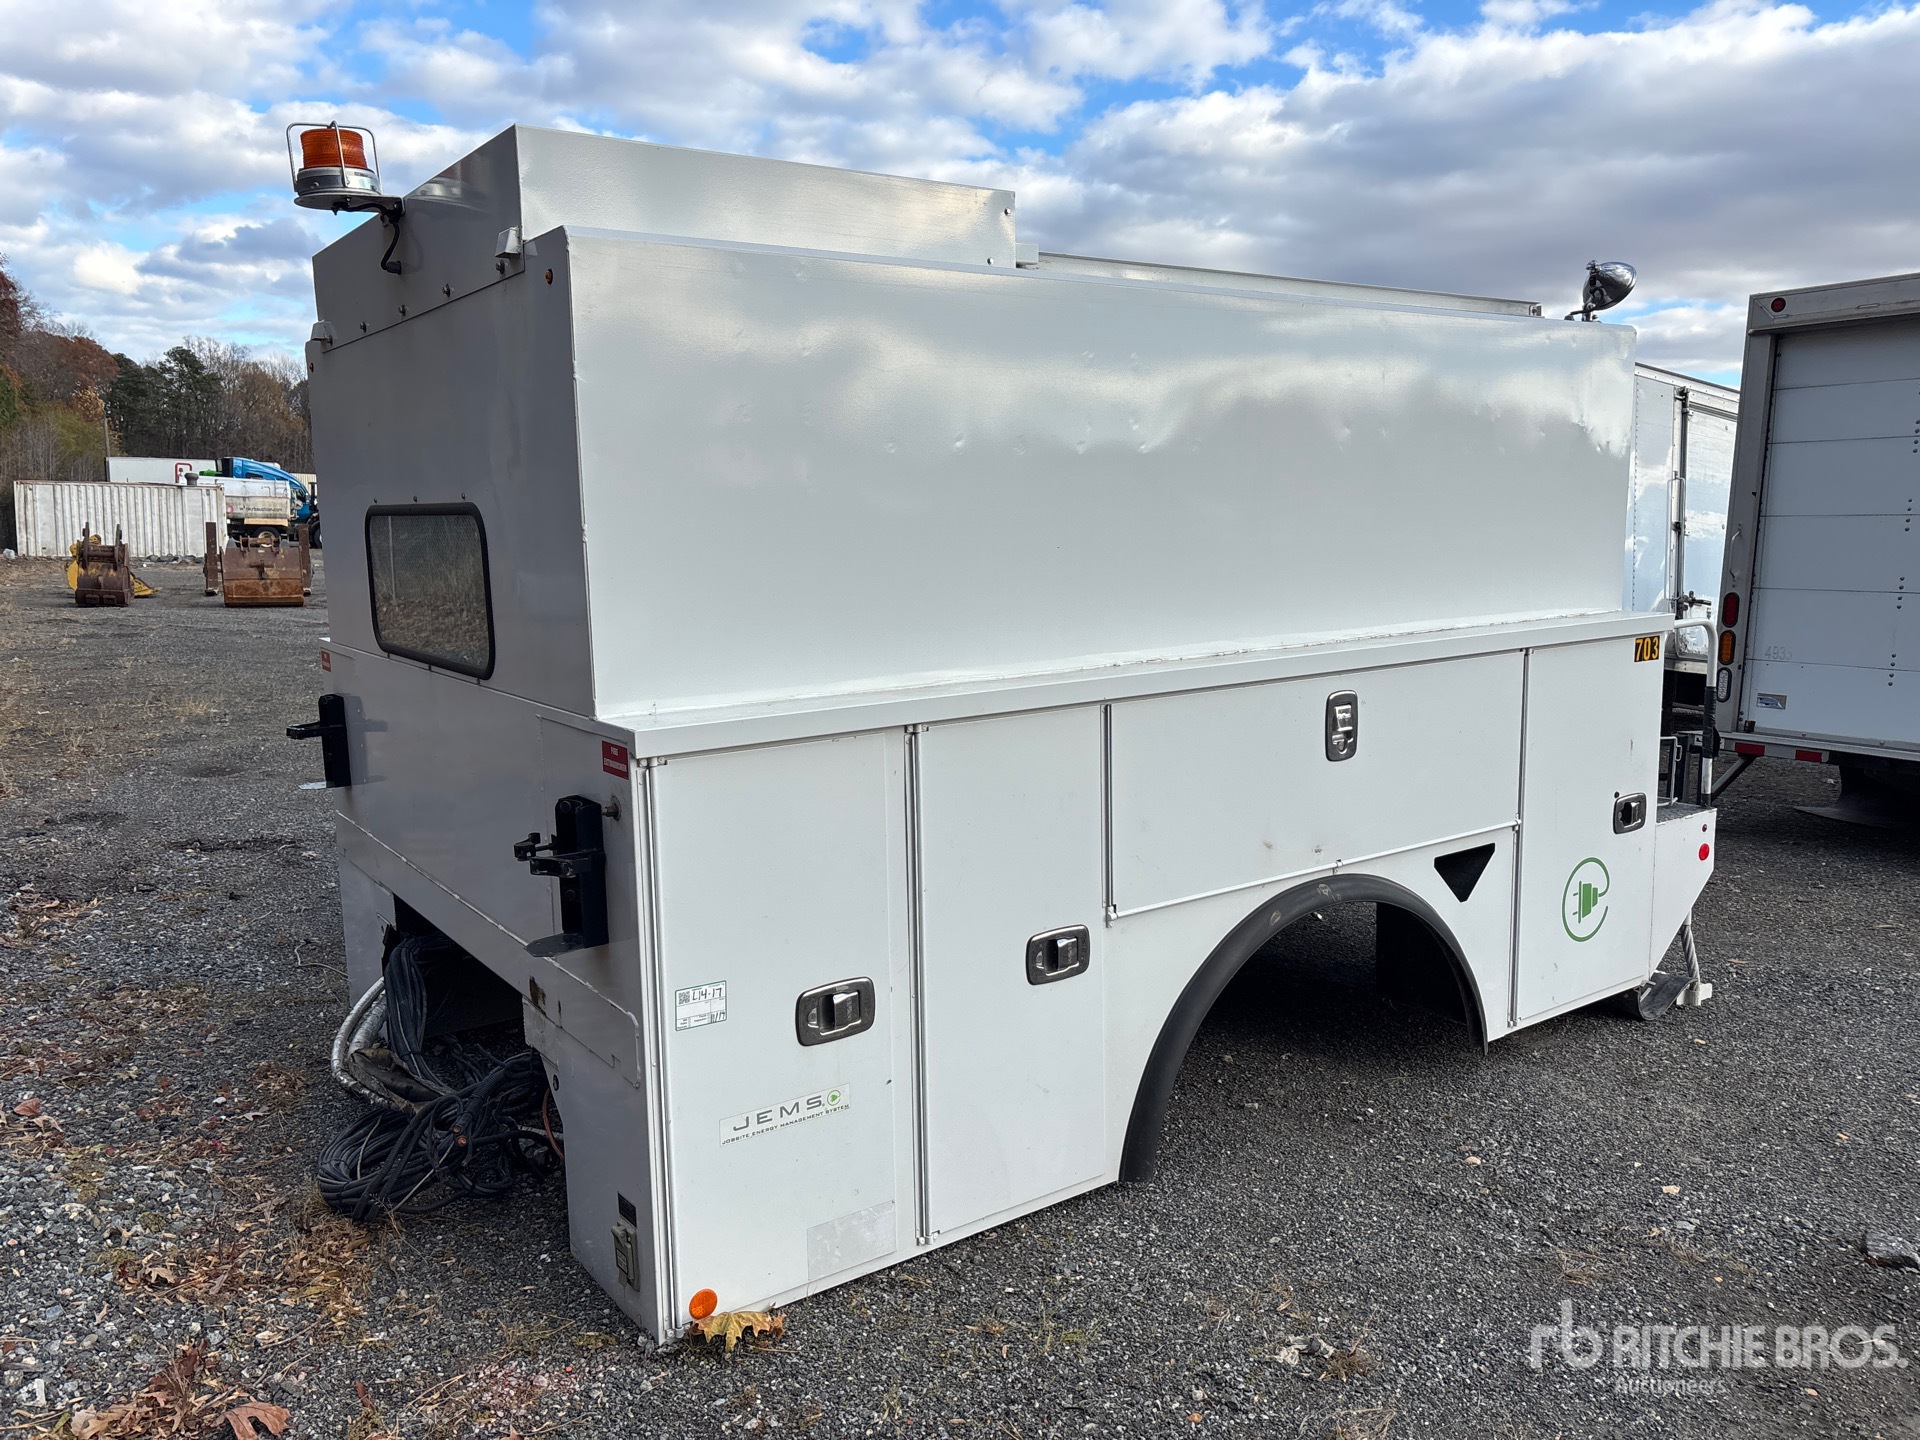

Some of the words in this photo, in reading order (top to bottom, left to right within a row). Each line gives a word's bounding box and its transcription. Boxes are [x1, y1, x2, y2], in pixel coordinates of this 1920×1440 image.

[1635, 637, 1659, 662] 703
[721, 1133, 750, 1145] JOBSITE
[751, 1124, 779, 1137] ENERGY
[780, 1111, 824, 1128] MANAGEMENT
[825, 1103, 850, 1115] SYSTEM
[732, 1094, 822, 1132] JEMS
